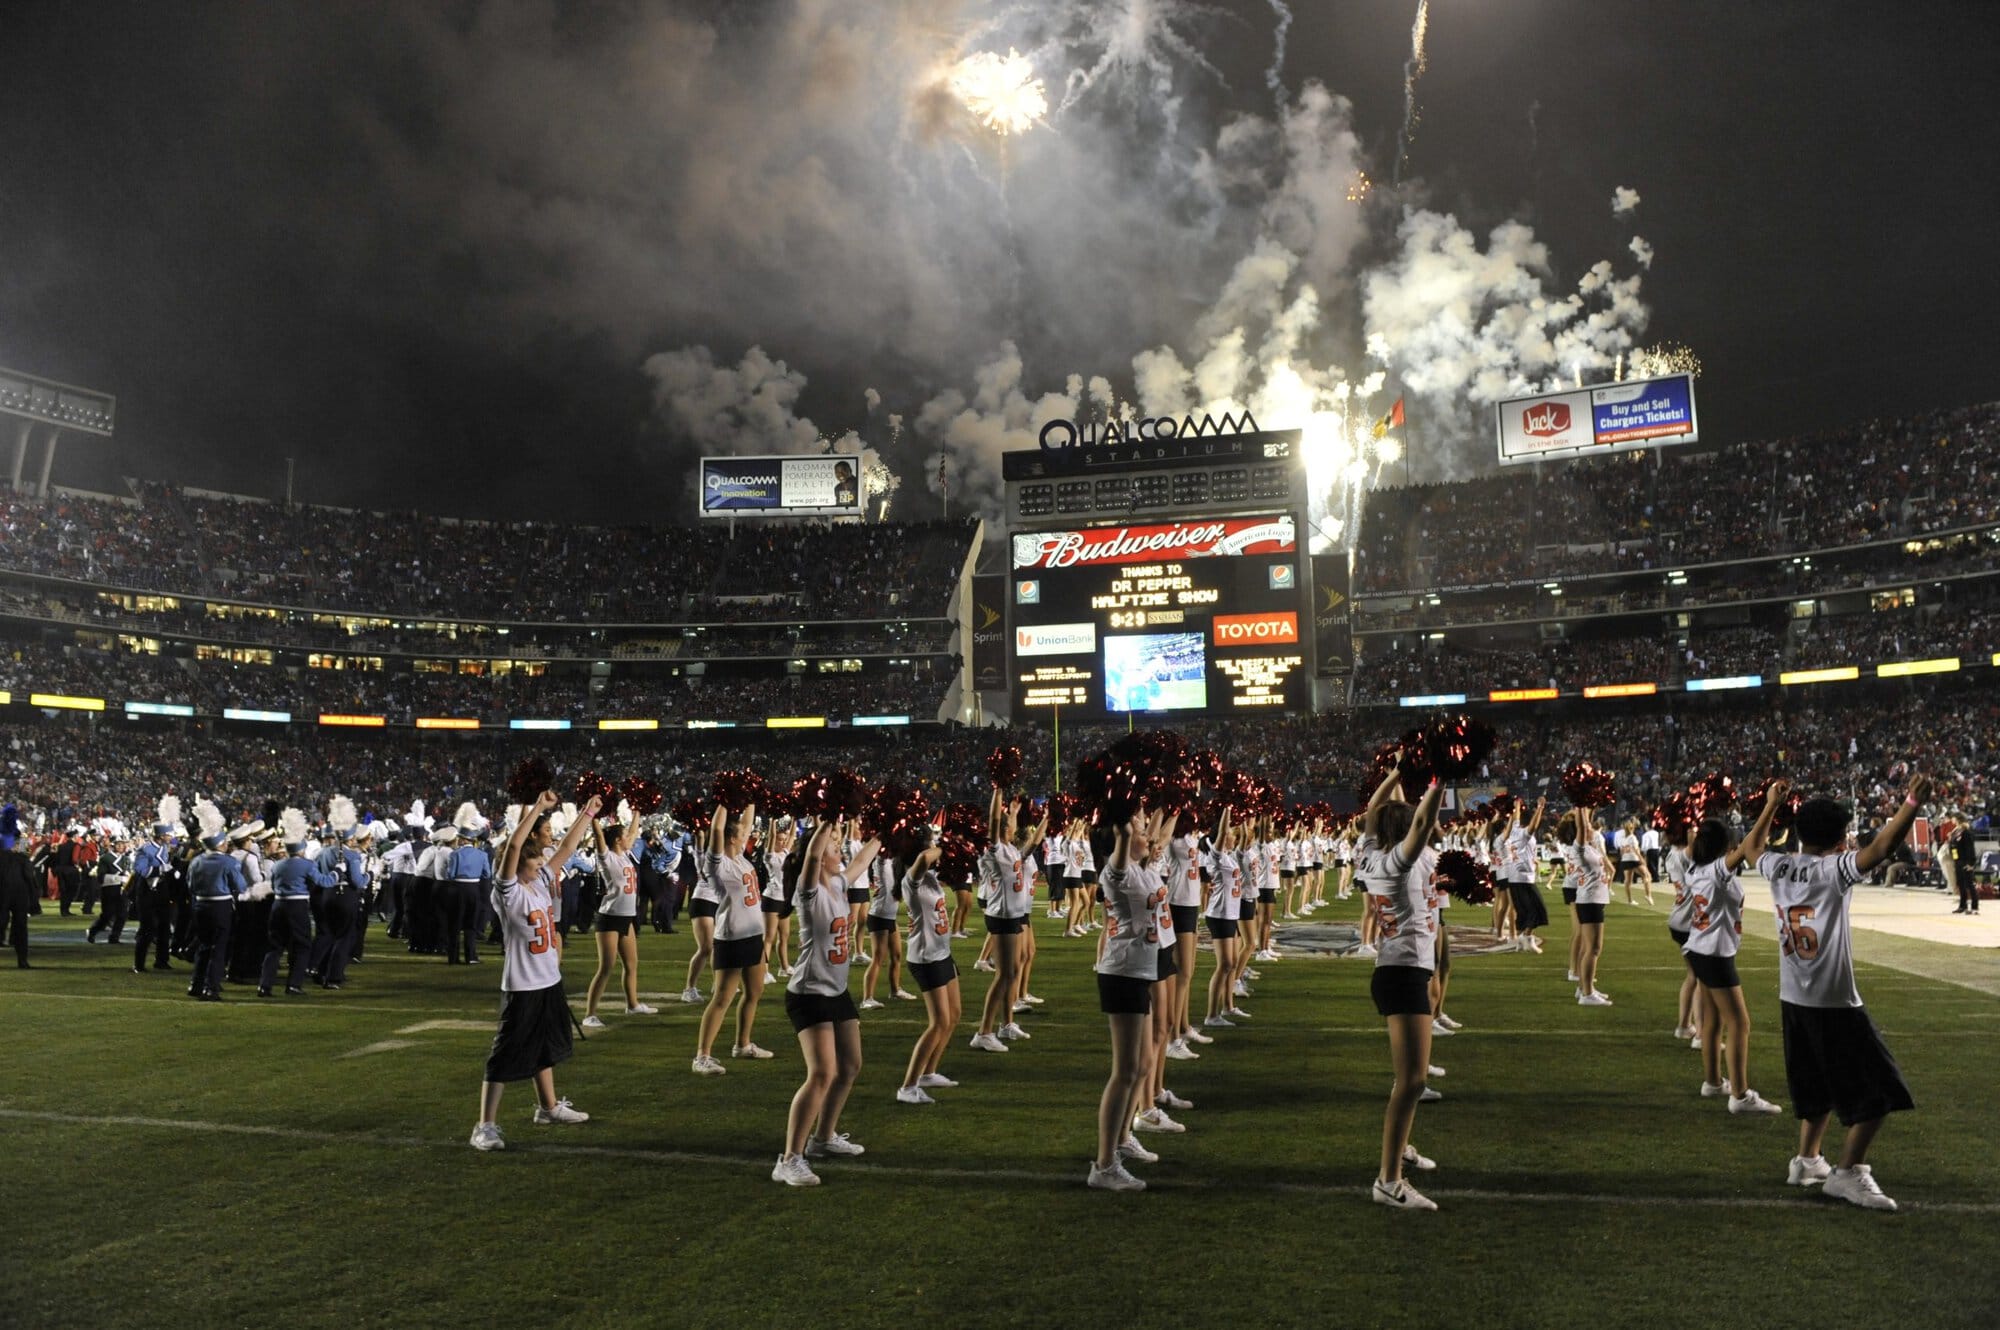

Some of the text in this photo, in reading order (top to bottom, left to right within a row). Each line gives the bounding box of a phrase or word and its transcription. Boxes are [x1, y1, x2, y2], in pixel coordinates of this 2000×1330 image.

[1611, 397, 1670, 416] Buy and Sell
[1525, 405, 1569, 434] Jack
[1600, 408, 1684, 429] Chargers Tickets!
[1040, 410, 1259, 449] QUALCOMM
[1085, 443, 1242, 463] STADIUM
[785, 463, 833, 471] PALOMAR
[707, 475, 778, 490] QUALCOMM
[785, 472, 833, 480] POMERADO
[785, 480, 833, 488] HEALTH
[1040, 523, 1225, 568] Budweiser
[1122, 564, 1182, 577] THANKS TO
[1112, 576, 1192, 592] DR PEPPER
[1092, 589, 1218, 608] HALFTIME SHOW
[1316, 612, 1349, 628] Sprint
[1217, 621, 1294, 639] TOYOTA
[974, 632, 1004, 645] Sprint
[1036, 633, 1093, 645] UnionBank
